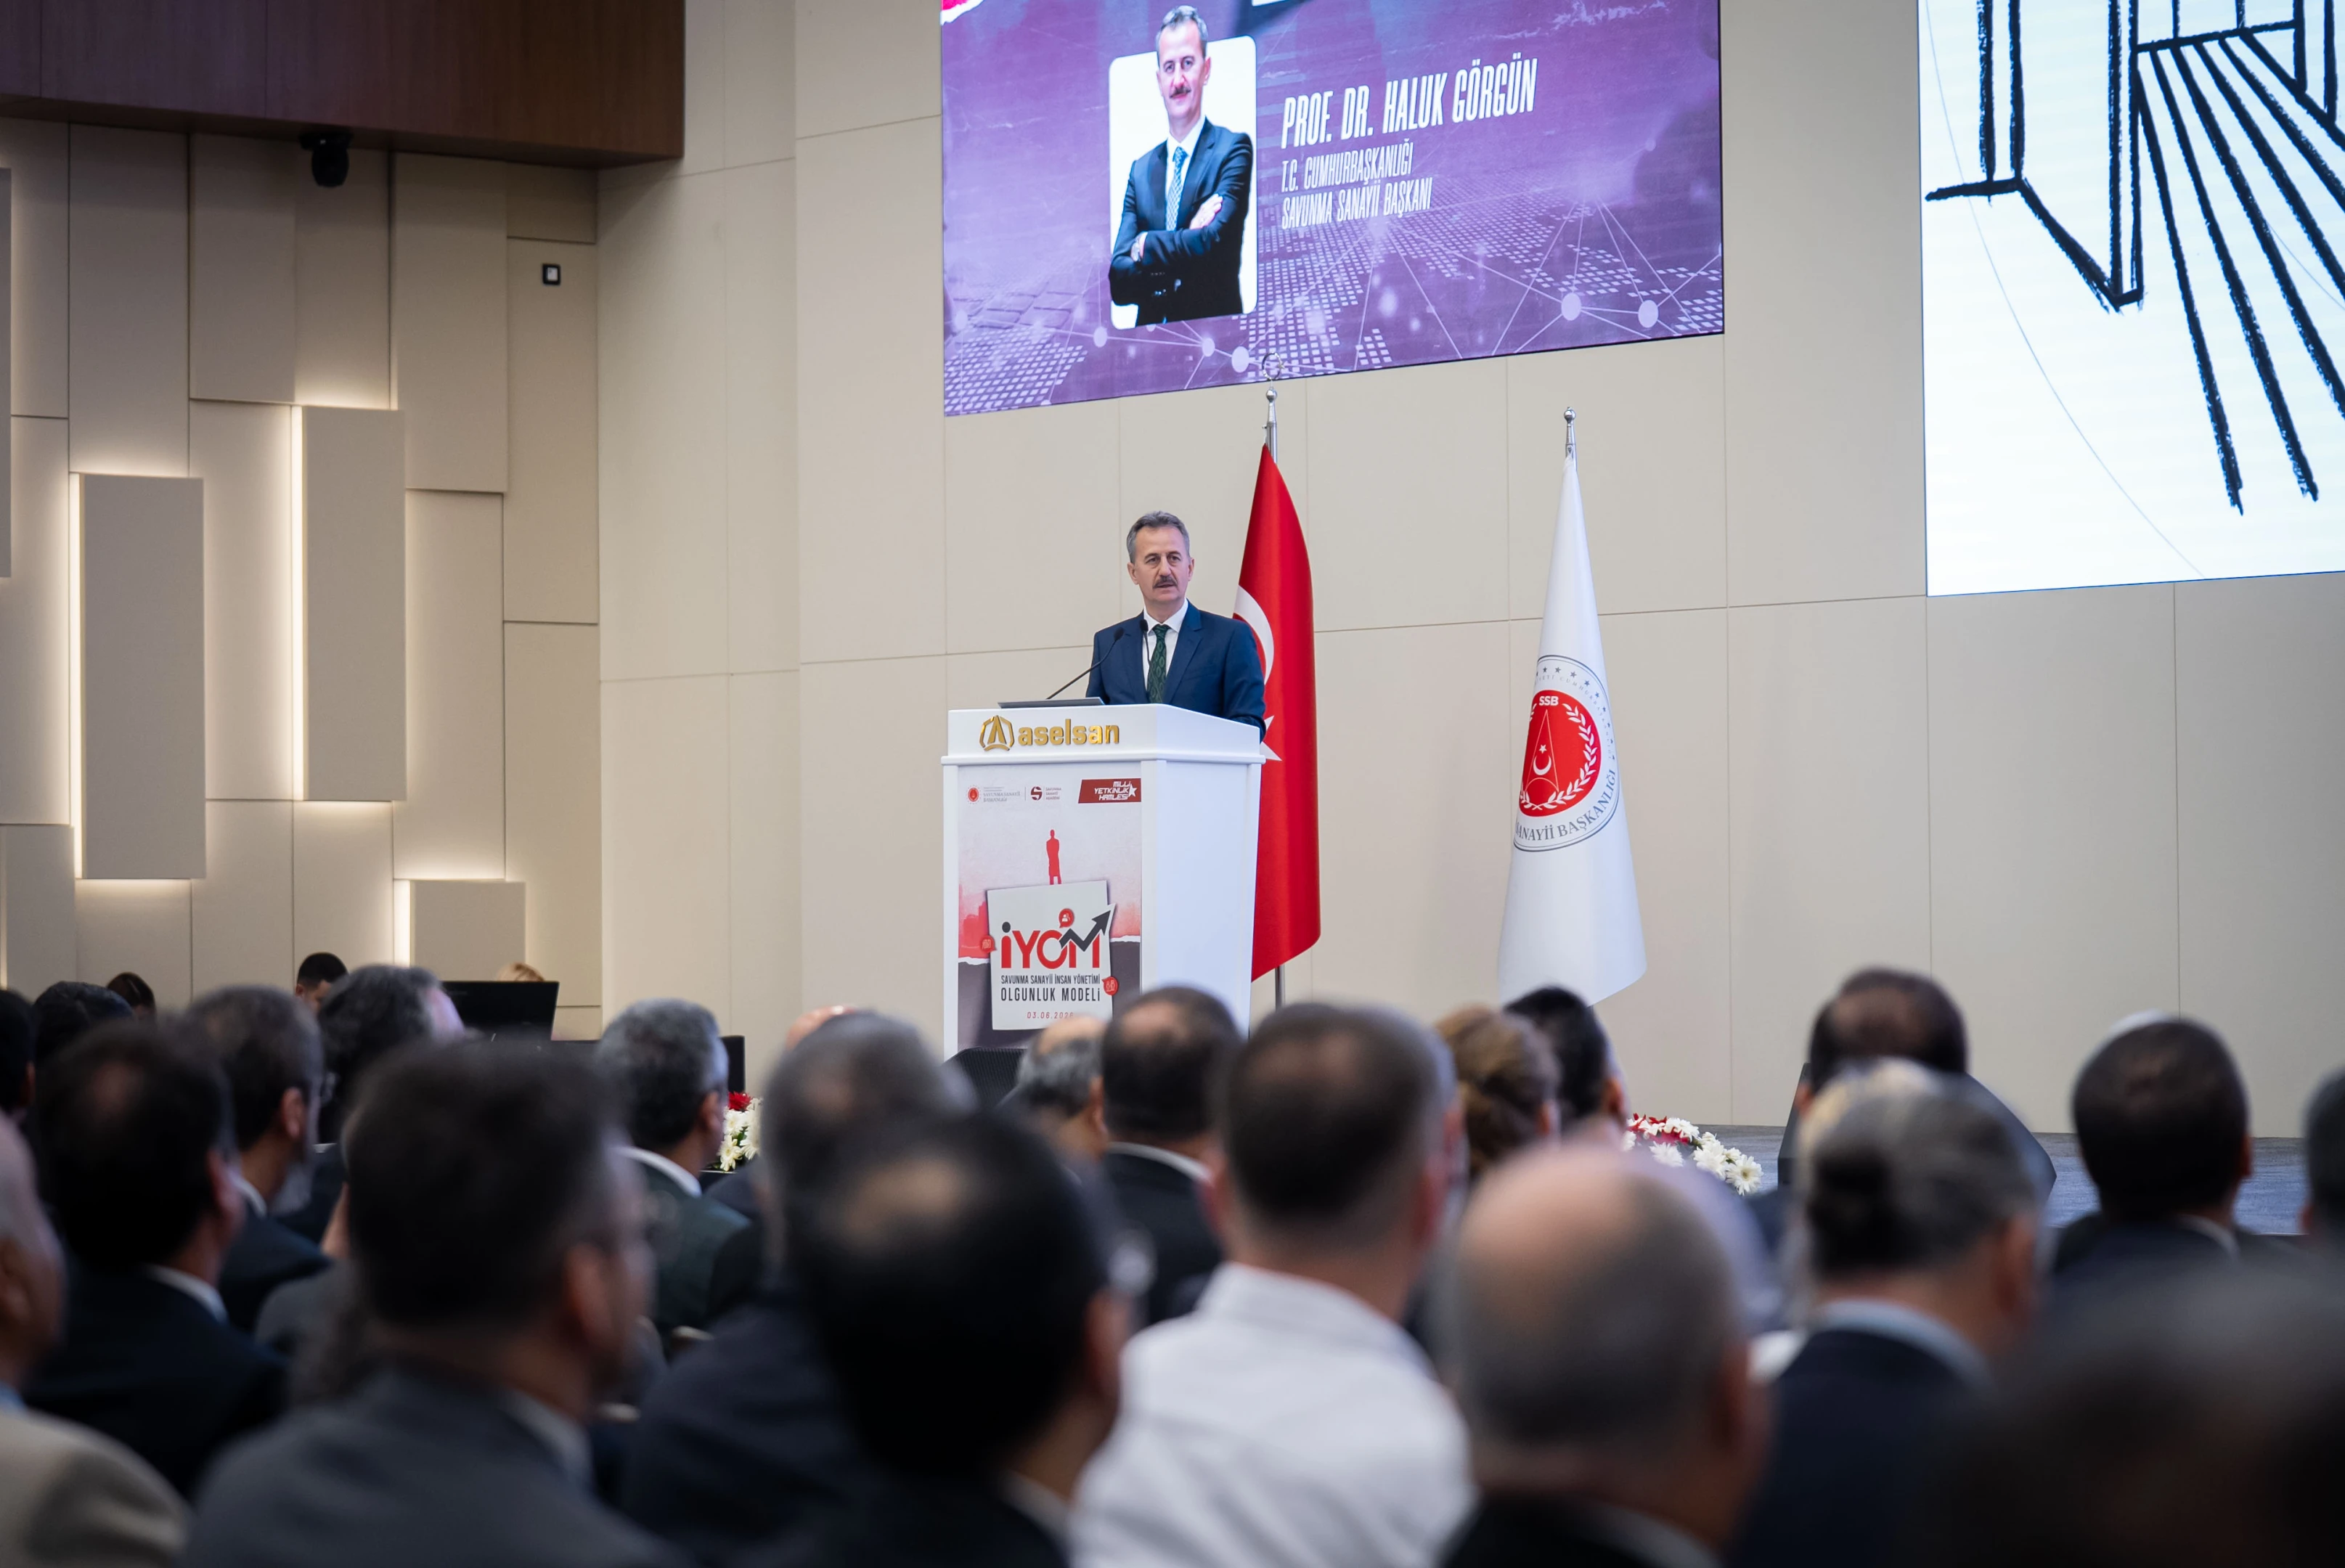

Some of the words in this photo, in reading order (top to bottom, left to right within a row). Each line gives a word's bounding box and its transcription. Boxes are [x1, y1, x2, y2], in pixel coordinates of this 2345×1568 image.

[1281, 90, 1334, 150] PROF.
[1340, 85, 1374, 140] DR.
[1382, 72, 1448, 134] HALUK
[1452, 52, 1538, 123] GÖRGÜN
[1281, 159, 1298, 192] T.C.
[1304, 138, 1414, 189] CUMHURBAŞKANLIĞI
[1281, 192, 1332, 230] SAVUNMA
[1337, 179, 1380, 222] SANAYİİ
[1383, 177, 1432, 218] BAŞKANI
[1538, 695, 1559, 706] SSB
[1018, 719, 1120, 746] aselsan
[1557, 769, 1616, 837] BAŞKANLIĞI
[1000, 987, 1056, 1002] OLGUNLUK
[1001, 975, 1029, 984] SAVUNMA
[1031, 973, 1053, 984] SANAYİİ
[1055, 973, 1072, 984] İNSAN
[1073, 973, 1101, 984] YÖNETİMİ
